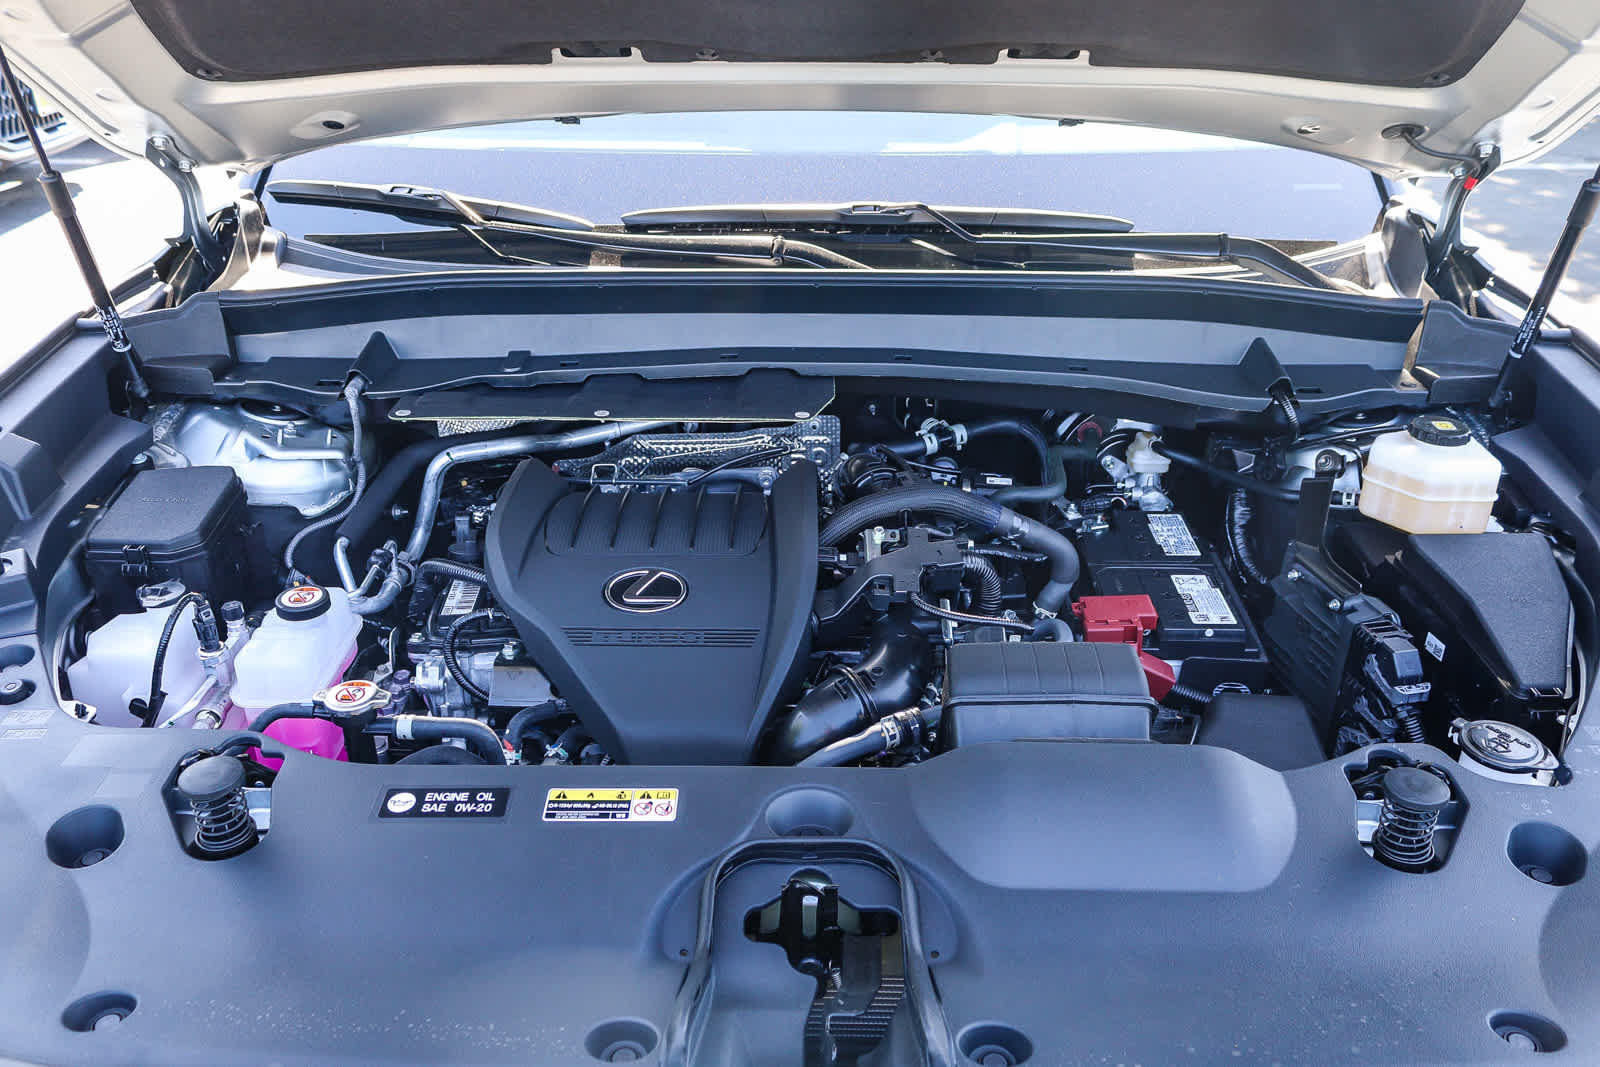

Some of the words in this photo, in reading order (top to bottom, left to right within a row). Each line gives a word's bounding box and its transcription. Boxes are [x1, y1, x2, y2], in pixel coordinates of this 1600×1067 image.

[424, 792, 470, 802] ENGINE
[476, 792, 496, 802] OIL
[421, 803, 447, 813] SAE
[454, 803, 493, 813] 0W-20
